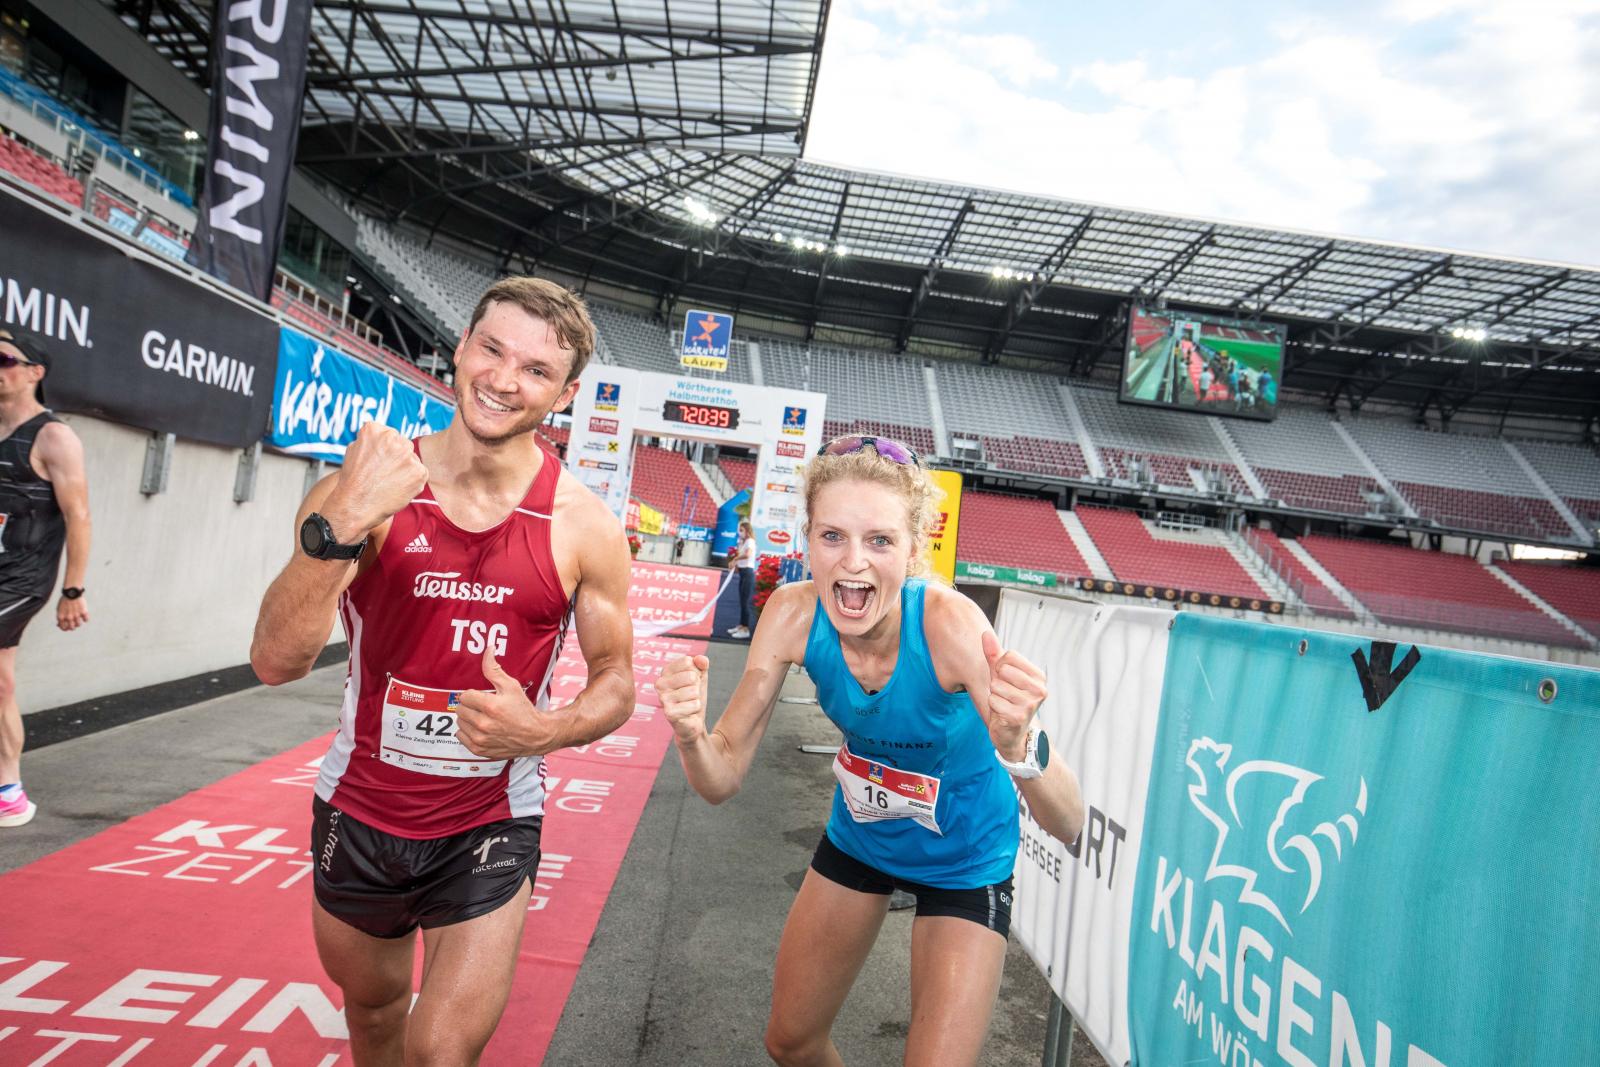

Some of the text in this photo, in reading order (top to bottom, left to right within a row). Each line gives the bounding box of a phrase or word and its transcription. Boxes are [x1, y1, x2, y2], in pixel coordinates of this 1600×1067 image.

[668, 390, 738, 406] Halbmarathon
[676, 381, 733, 395] Wörthersee
[413, 571, 514, 604] Teusser
[450, 618, 509, 657] TSG
[401, 690, 425, 699] KLEINE
[397, 721, 404, 730] 1
[415, 713, 459, 737] 42
[395, 732, 413, 742] Kleine
[880, 740, 935, 750] FINANZ
[864, 785, 889, 809] 16
[1151, 855, 1450, 1067] KLAGEN
[1172, 979, 1204, 1039] AM
